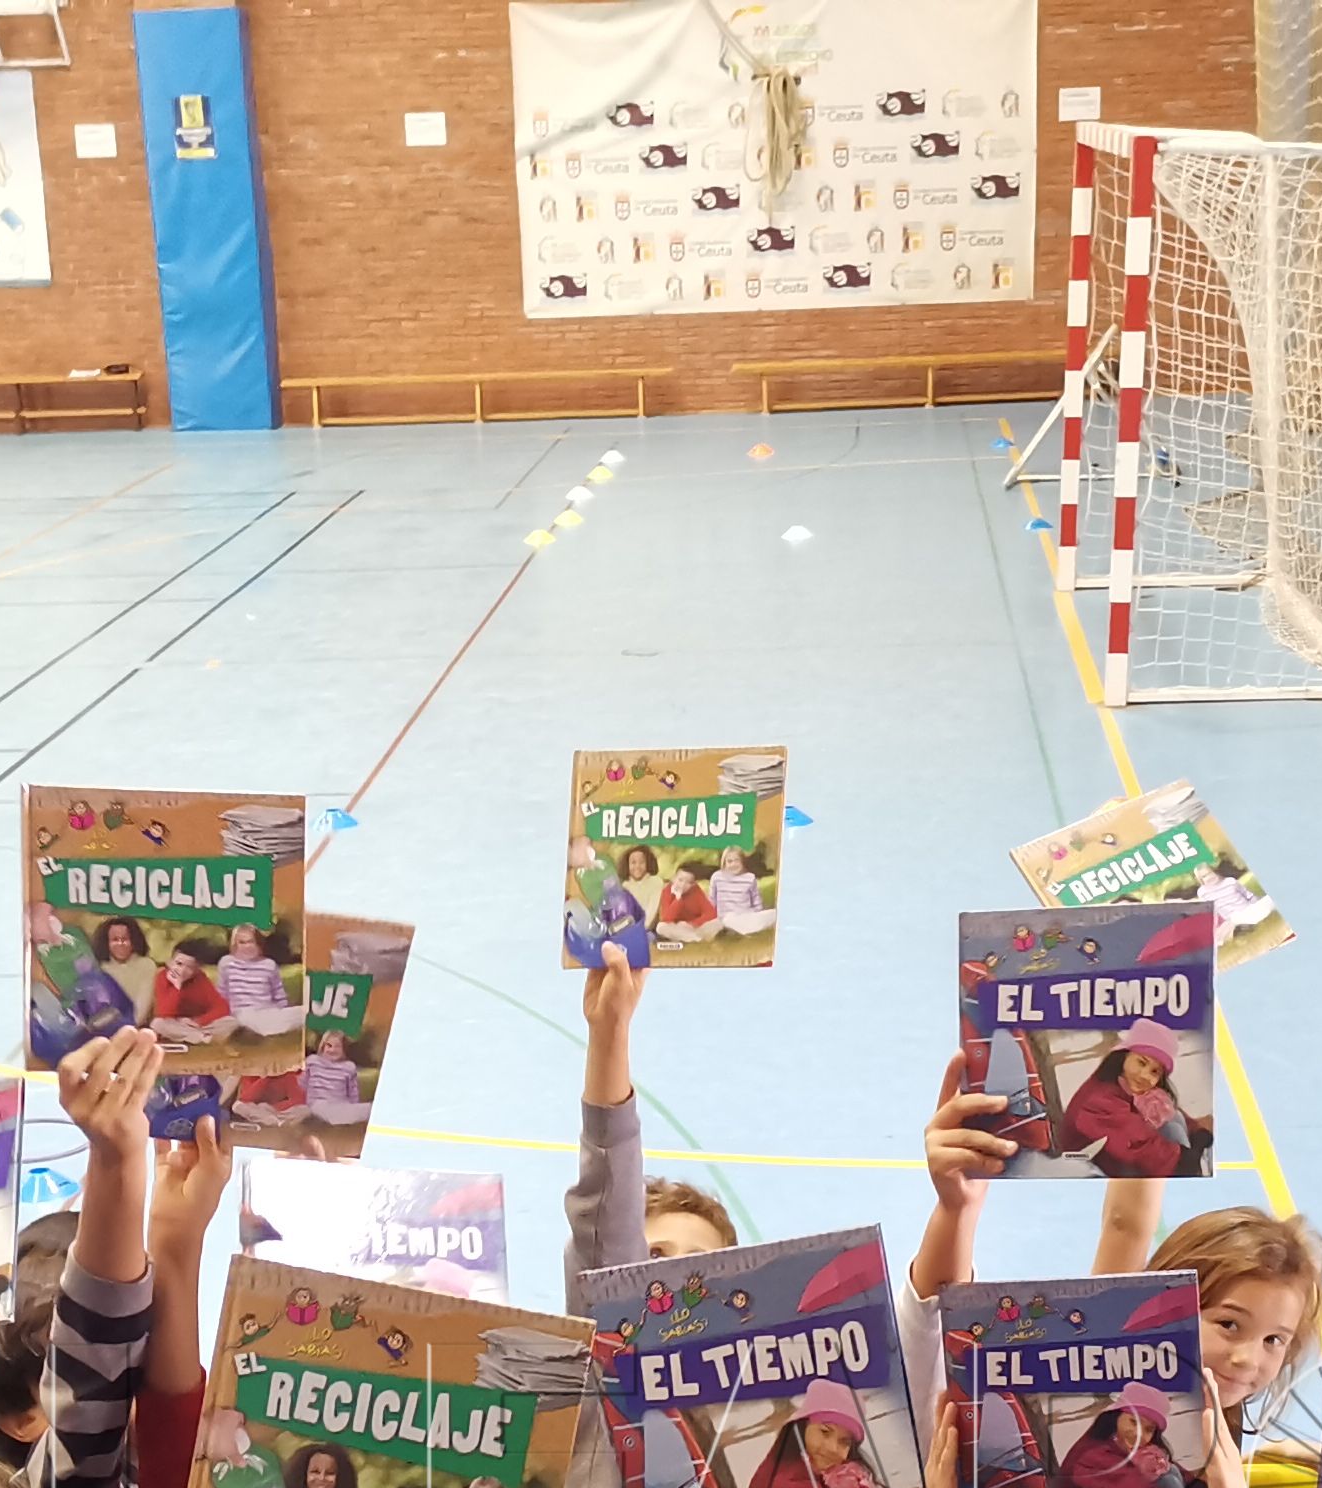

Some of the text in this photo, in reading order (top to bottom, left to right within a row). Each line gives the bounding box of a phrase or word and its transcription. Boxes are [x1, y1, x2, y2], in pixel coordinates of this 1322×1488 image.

[968, 235, 1004, 247] Ceuta
[580, 799, 744, 839] EL RECICLAJE
[36, 855, 257, 910] EL RECICLAJE
[1046, 832, 1199, 904] EL RECICLAJE
[996, 973, 1191, 1023] EL TIEMPO
[640, 1320, 870, 1402] EL TIEMPO
[986, 1340, 1179, 1387] EL TIEMPO
[233, 1352, 513, 1460] EL RECICLAJE
